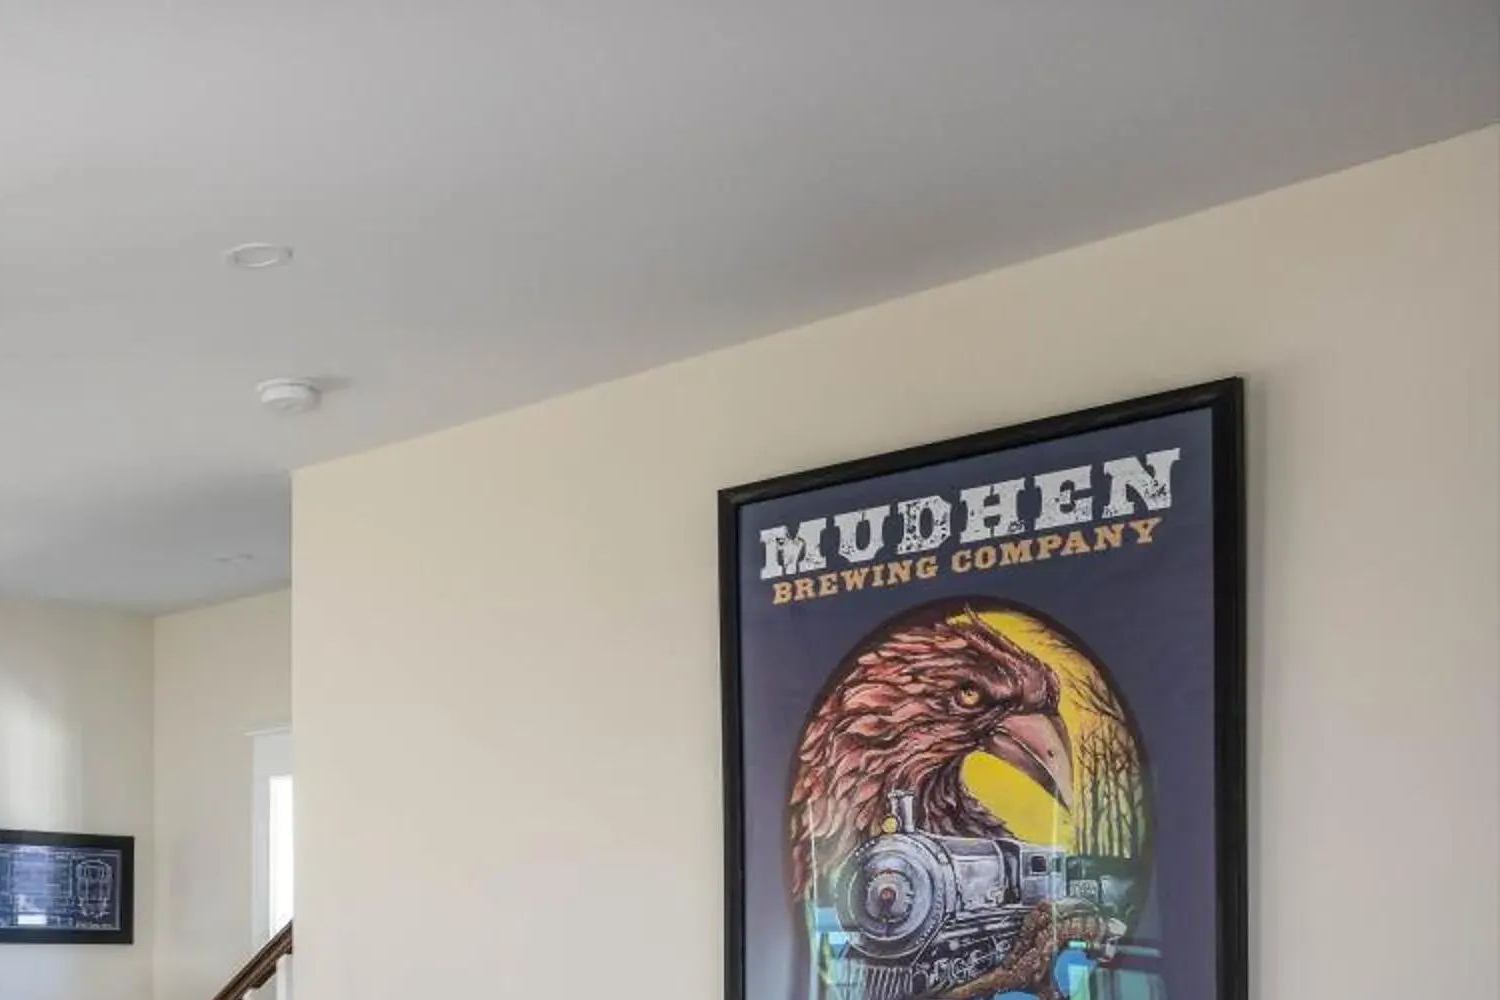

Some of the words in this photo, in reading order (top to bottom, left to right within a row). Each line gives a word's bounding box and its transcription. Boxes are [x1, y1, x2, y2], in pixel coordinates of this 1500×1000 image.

[759, 448, 1181, 581] MUDHEN
[772, 555, 939, 606] BREWING
[951, 517, 1162, 573] COMPANY
